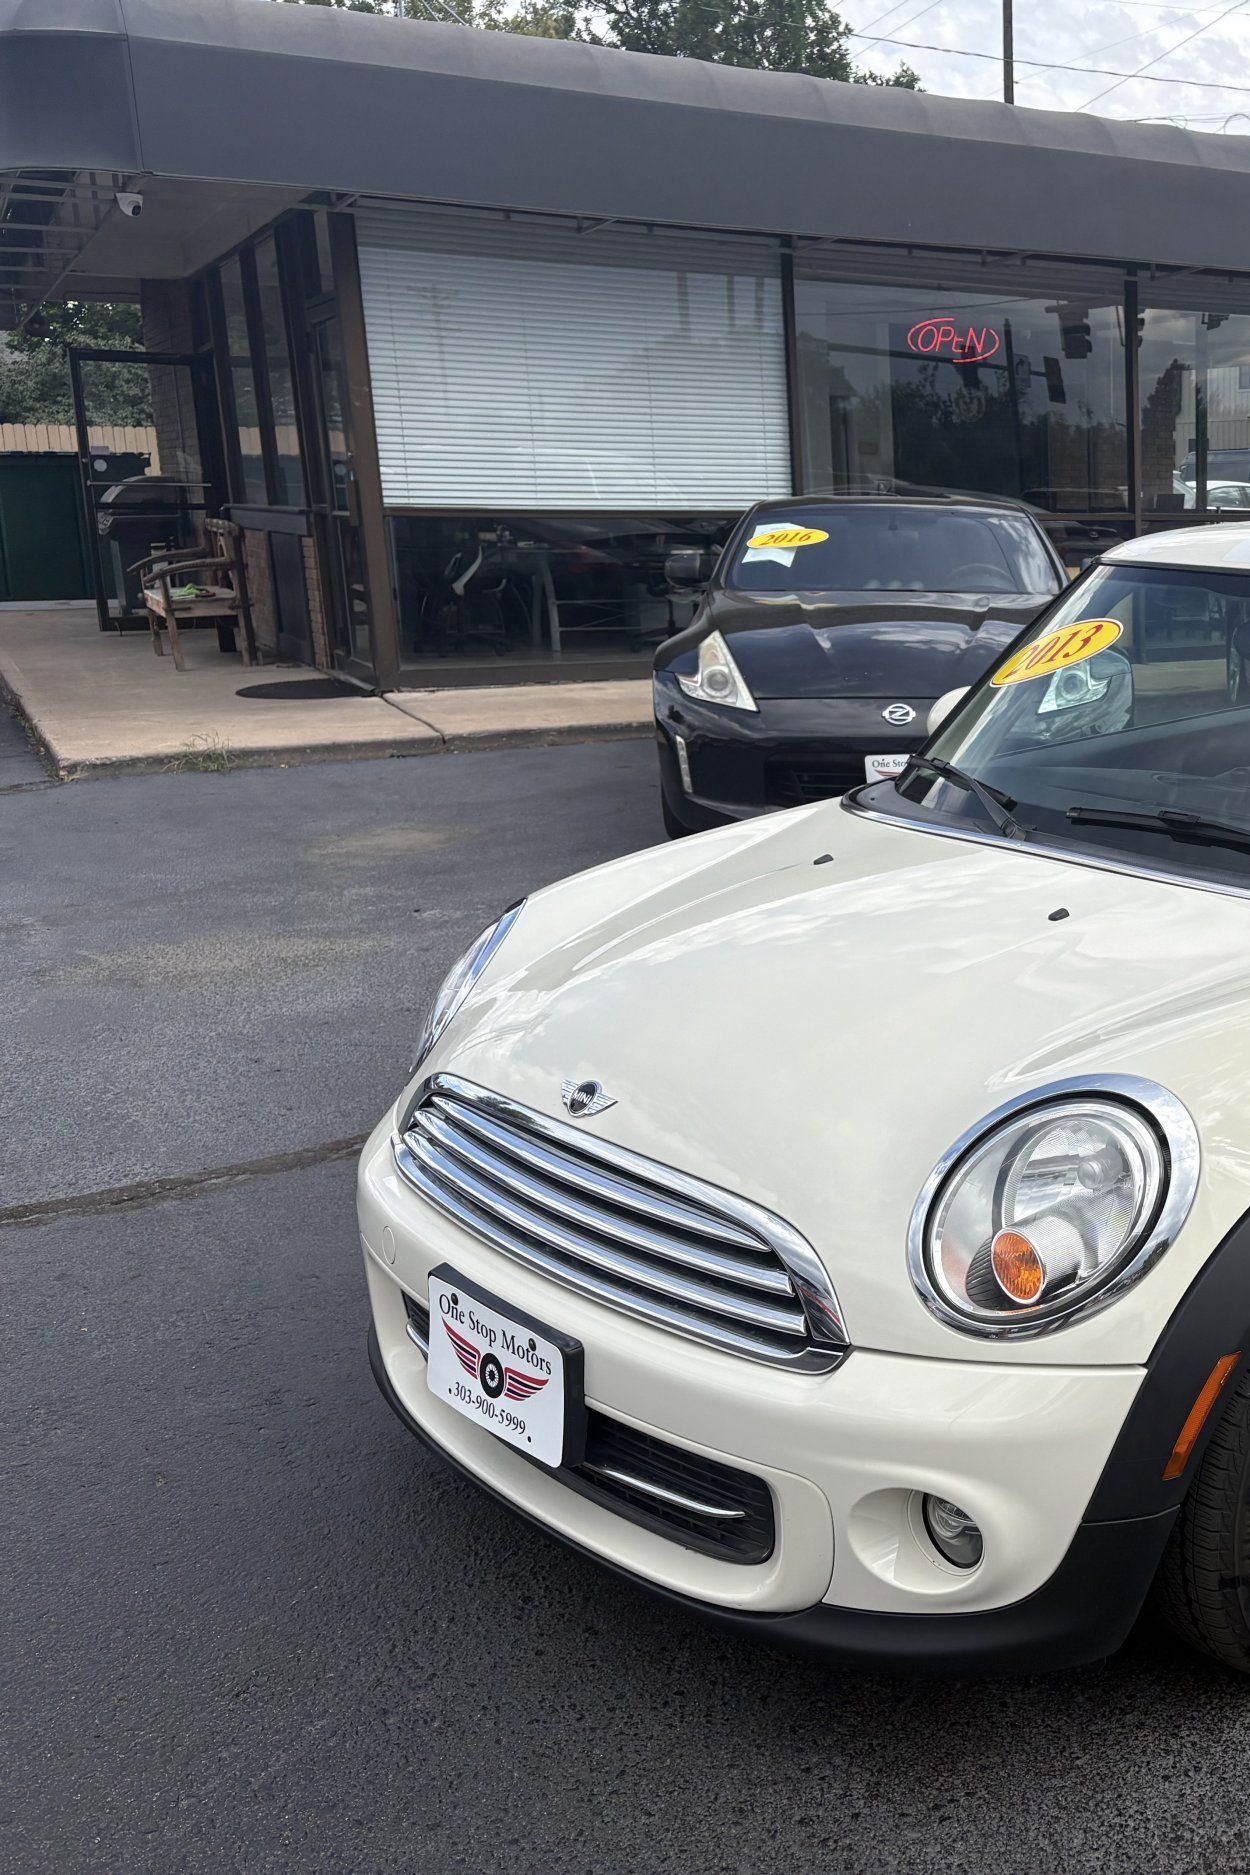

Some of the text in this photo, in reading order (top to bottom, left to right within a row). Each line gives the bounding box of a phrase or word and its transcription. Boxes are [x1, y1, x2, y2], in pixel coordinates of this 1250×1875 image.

[918, 326, 987, 353] OPEN
[759, 531, 814, 546] 2016
[1002, 624, 1104, 680] 2013
[871, 760, 890, 768] One
[573, 1089, 593, 1104] MINI
[439, 1293, 552, 1376] One Stop Motors
[454, 1381, 526, 1434] 303-900-5999
